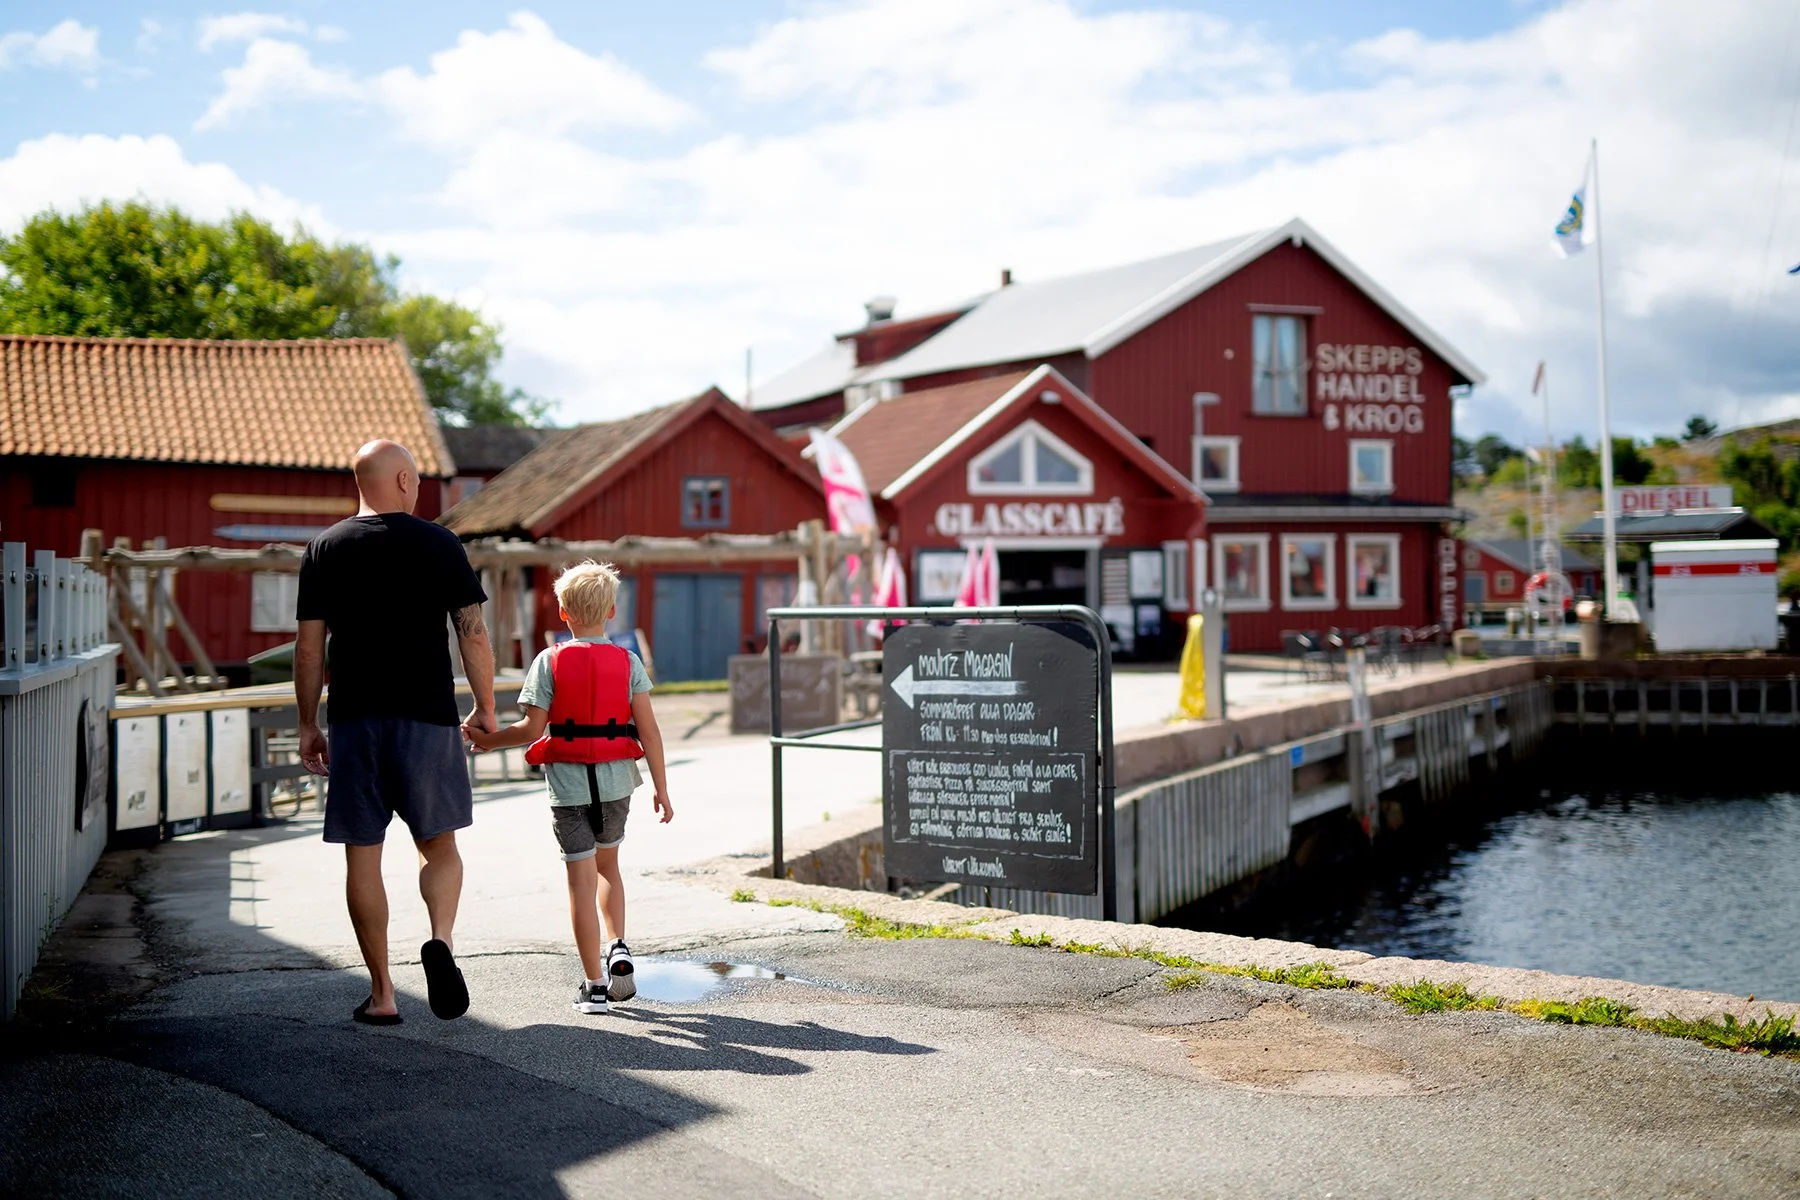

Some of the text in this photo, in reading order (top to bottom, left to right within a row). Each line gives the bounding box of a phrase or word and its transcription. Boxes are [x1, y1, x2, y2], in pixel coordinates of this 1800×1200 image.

[1315, 342, 1424, 376] SKEPPS
[1316, 373, 1425, 404] HANDEL
[1323, 403, 1424, 434] & KROG
[1621, 487, 1717, 511] DIESEL
[936, 496, 1125, 537] GLASSCAFÉ
[918, 642, 1014, 678] MOVITZ MAGASIN
[980, 702, 1001, 720] ALLA
[1003, 701, 1036, 721] DAGAR
[920, 720, 942, 742] FRÅN
[972, 763, 986, 777] GOD
[1053, 764, 1078, 781] CARTE,
[944, 776, 964, 791] PIZZA
[964, 776, 974, 792] PÅ
[1032, 780, 1054, 793] SAMT
[930, 805, 940, 821] EN
[978, 811, 992, 823] MED
[1018, 811, 1034, 826] BRA
